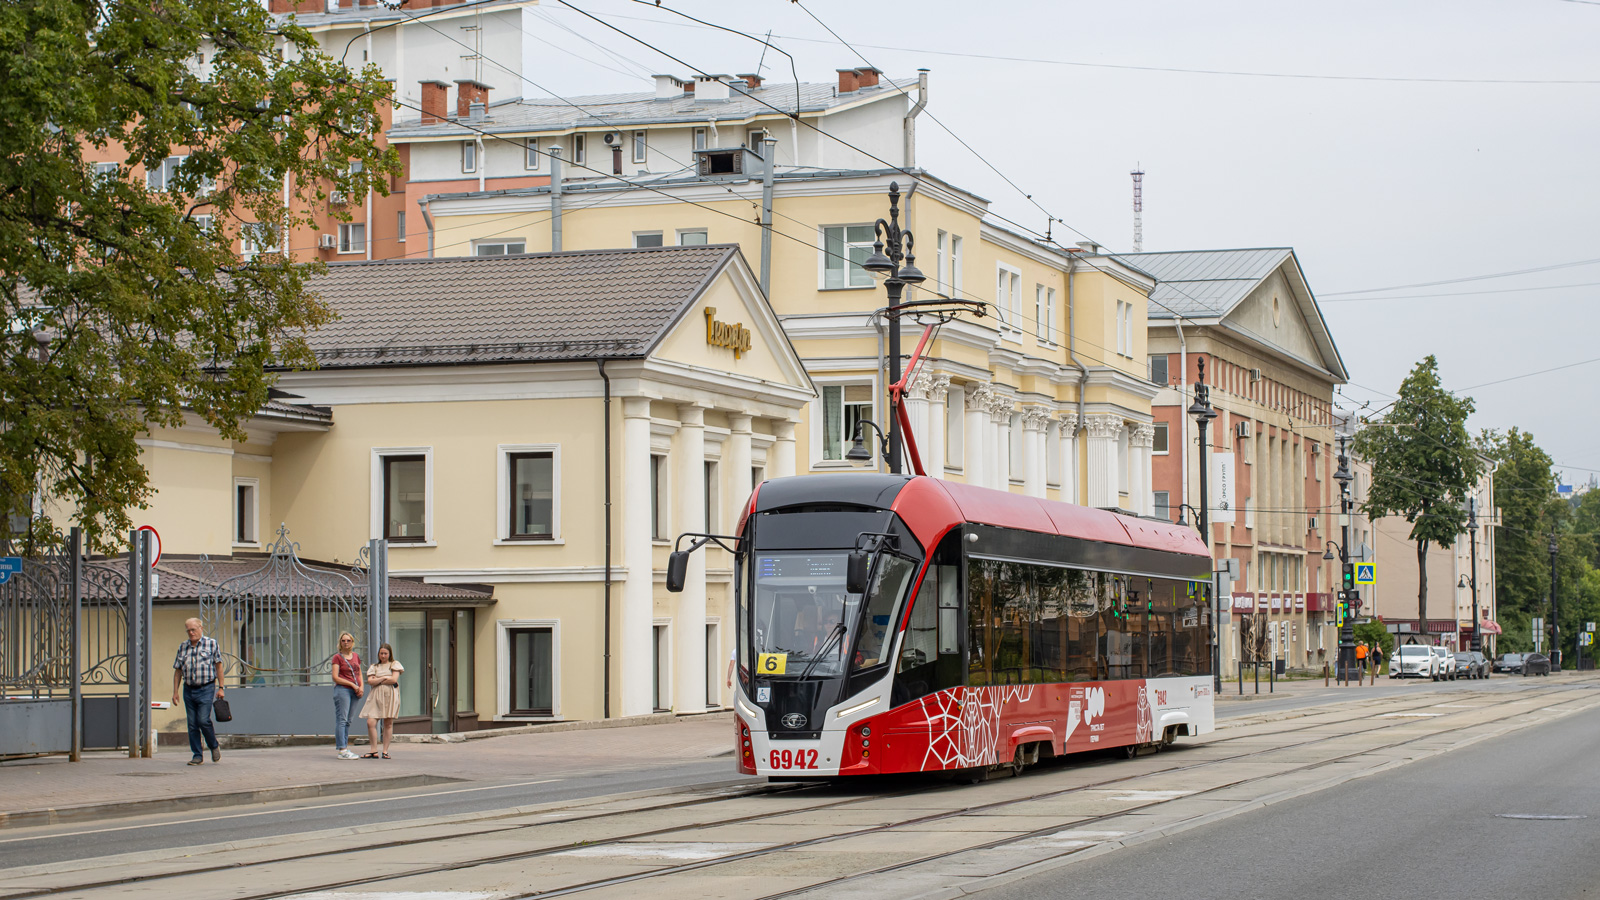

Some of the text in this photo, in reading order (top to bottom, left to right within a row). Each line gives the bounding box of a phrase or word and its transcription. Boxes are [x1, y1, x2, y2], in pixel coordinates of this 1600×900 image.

[765, 656, 778, 671] 6
[1157, 690, 1167, 706] 6942
[769, 749, 819, 770] 6942
